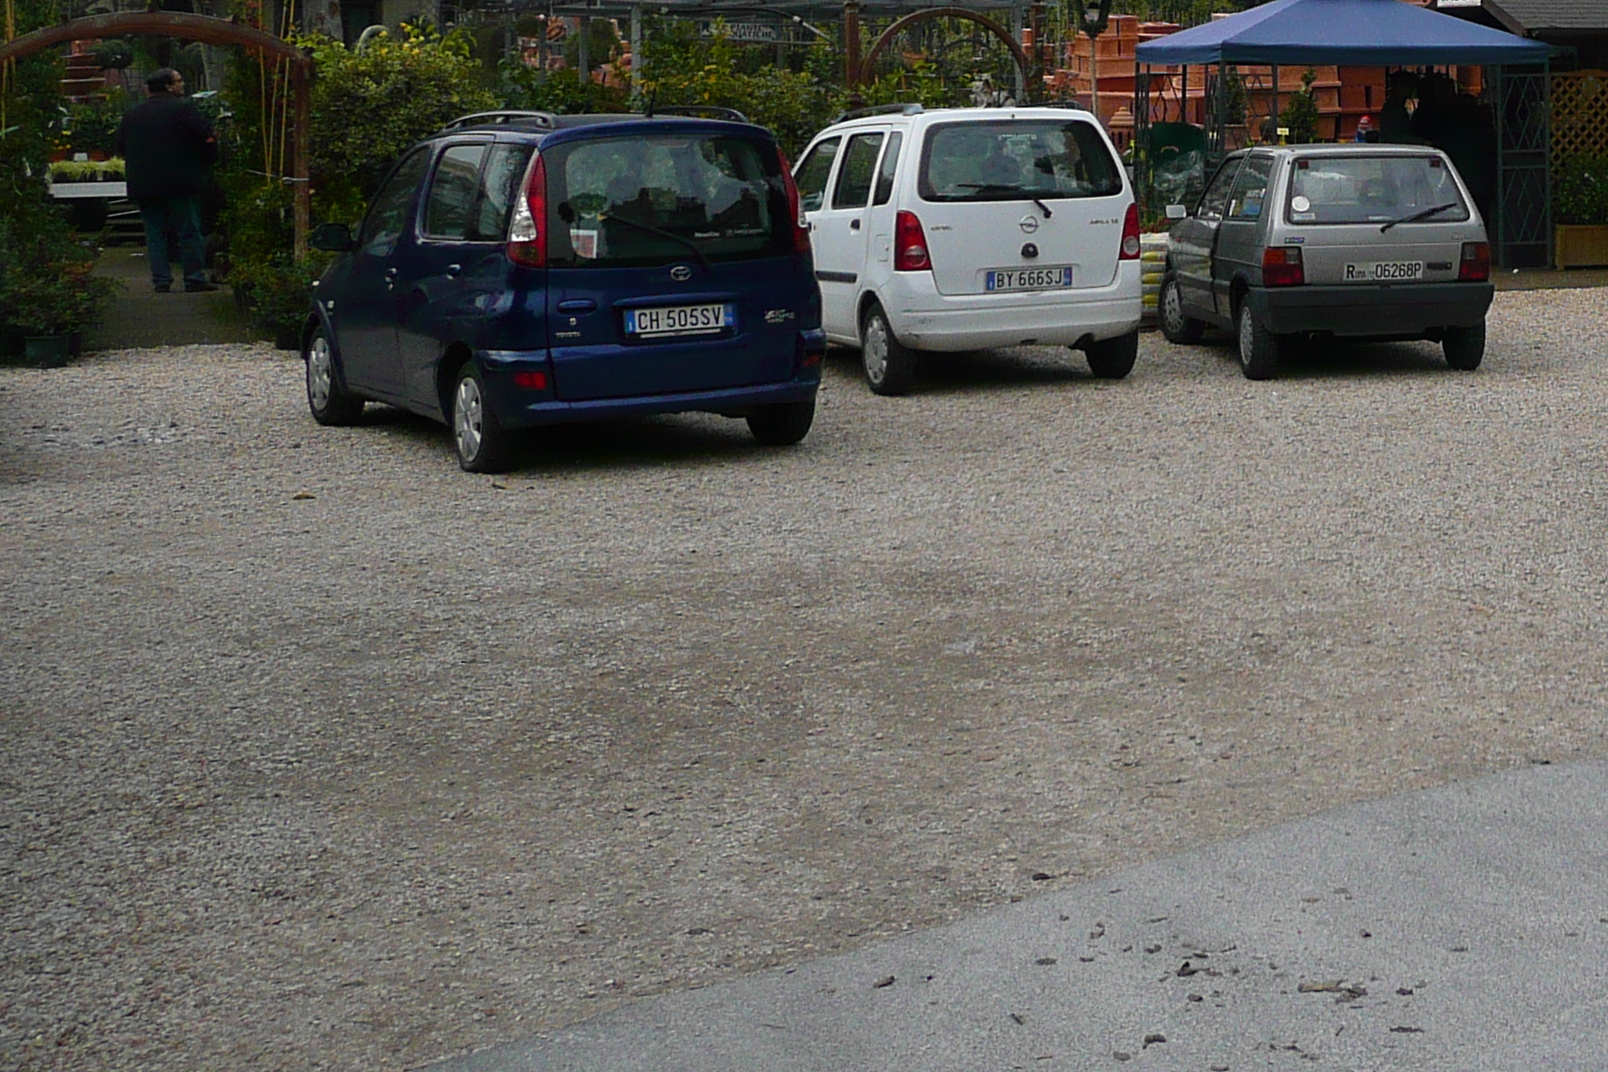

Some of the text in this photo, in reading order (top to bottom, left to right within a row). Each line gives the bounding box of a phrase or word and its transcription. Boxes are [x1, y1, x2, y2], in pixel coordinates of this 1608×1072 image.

[996, 270, 1063, 288] BY 666SJ
[1375, 262, 1422, 278] 06268P
[637, 307, 722, 330] CH 505SV
